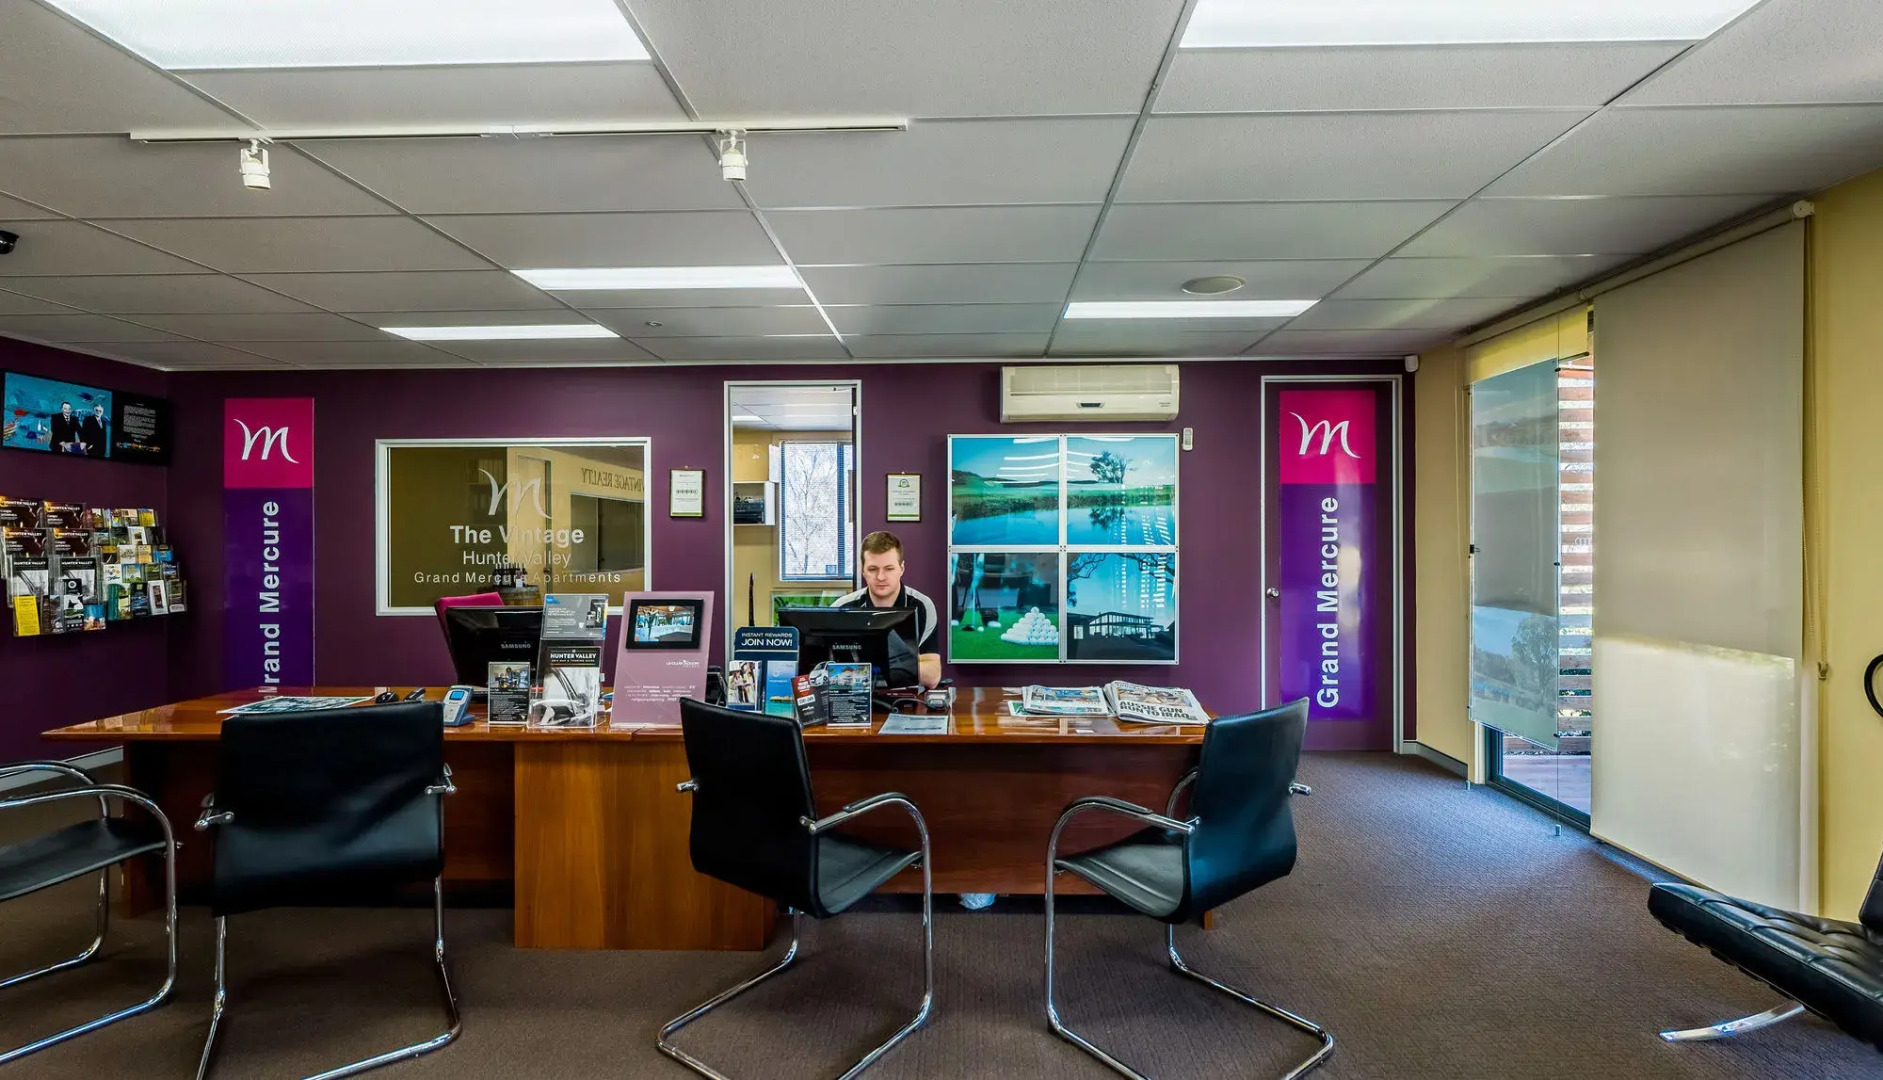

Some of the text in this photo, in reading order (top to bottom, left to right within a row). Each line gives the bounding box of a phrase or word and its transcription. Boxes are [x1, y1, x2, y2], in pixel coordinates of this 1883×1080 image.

[450, 525, 585, 548] The Vintage
[463, 551, 572, 568] Hunter Valley
[414, 572, 621, 586] Grand Mercure Apartments
[259, 501, 281, 684] rand Mercure
[1317, 497, 1339, 708] Grand Mercure
[741, 638, 793, 647] JOIN NOW!
[1120, 701, 1183, 714] AUSSIE GUN
[1161, 711, 1189, 719] IRAQ
